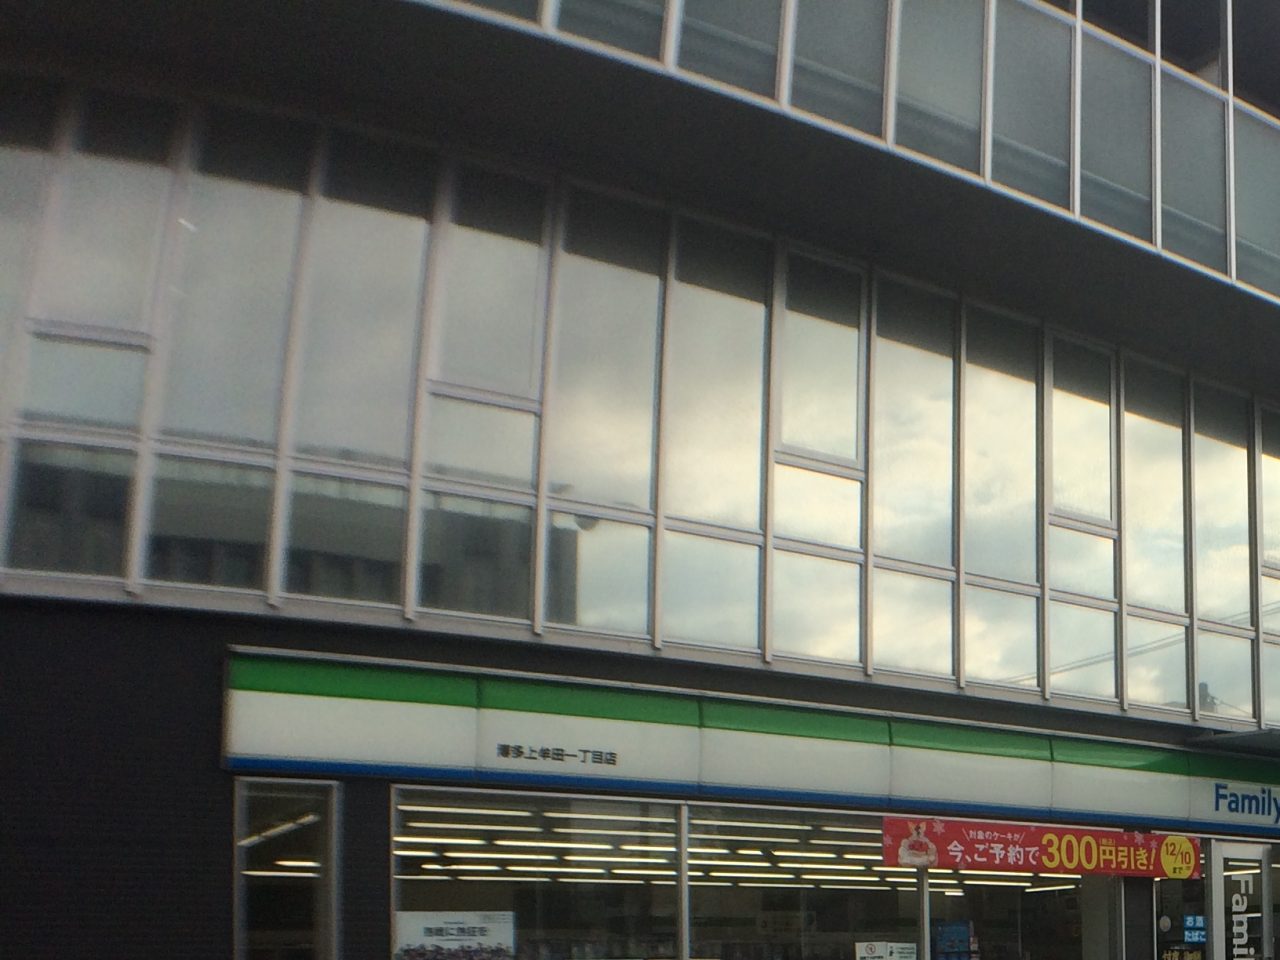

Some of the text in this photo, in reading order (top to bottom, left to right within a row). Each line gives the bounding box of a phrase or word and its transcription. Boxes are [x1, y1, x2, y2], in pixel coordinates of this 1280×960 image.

[497, 743, 618, 765] 博多上牟田一丁目店
[946, 841, 1040, 866] 今、ご予約で
[1165, 841, 1192, 866] 12/10
[1184, 930, 1208, 943] たばこ
